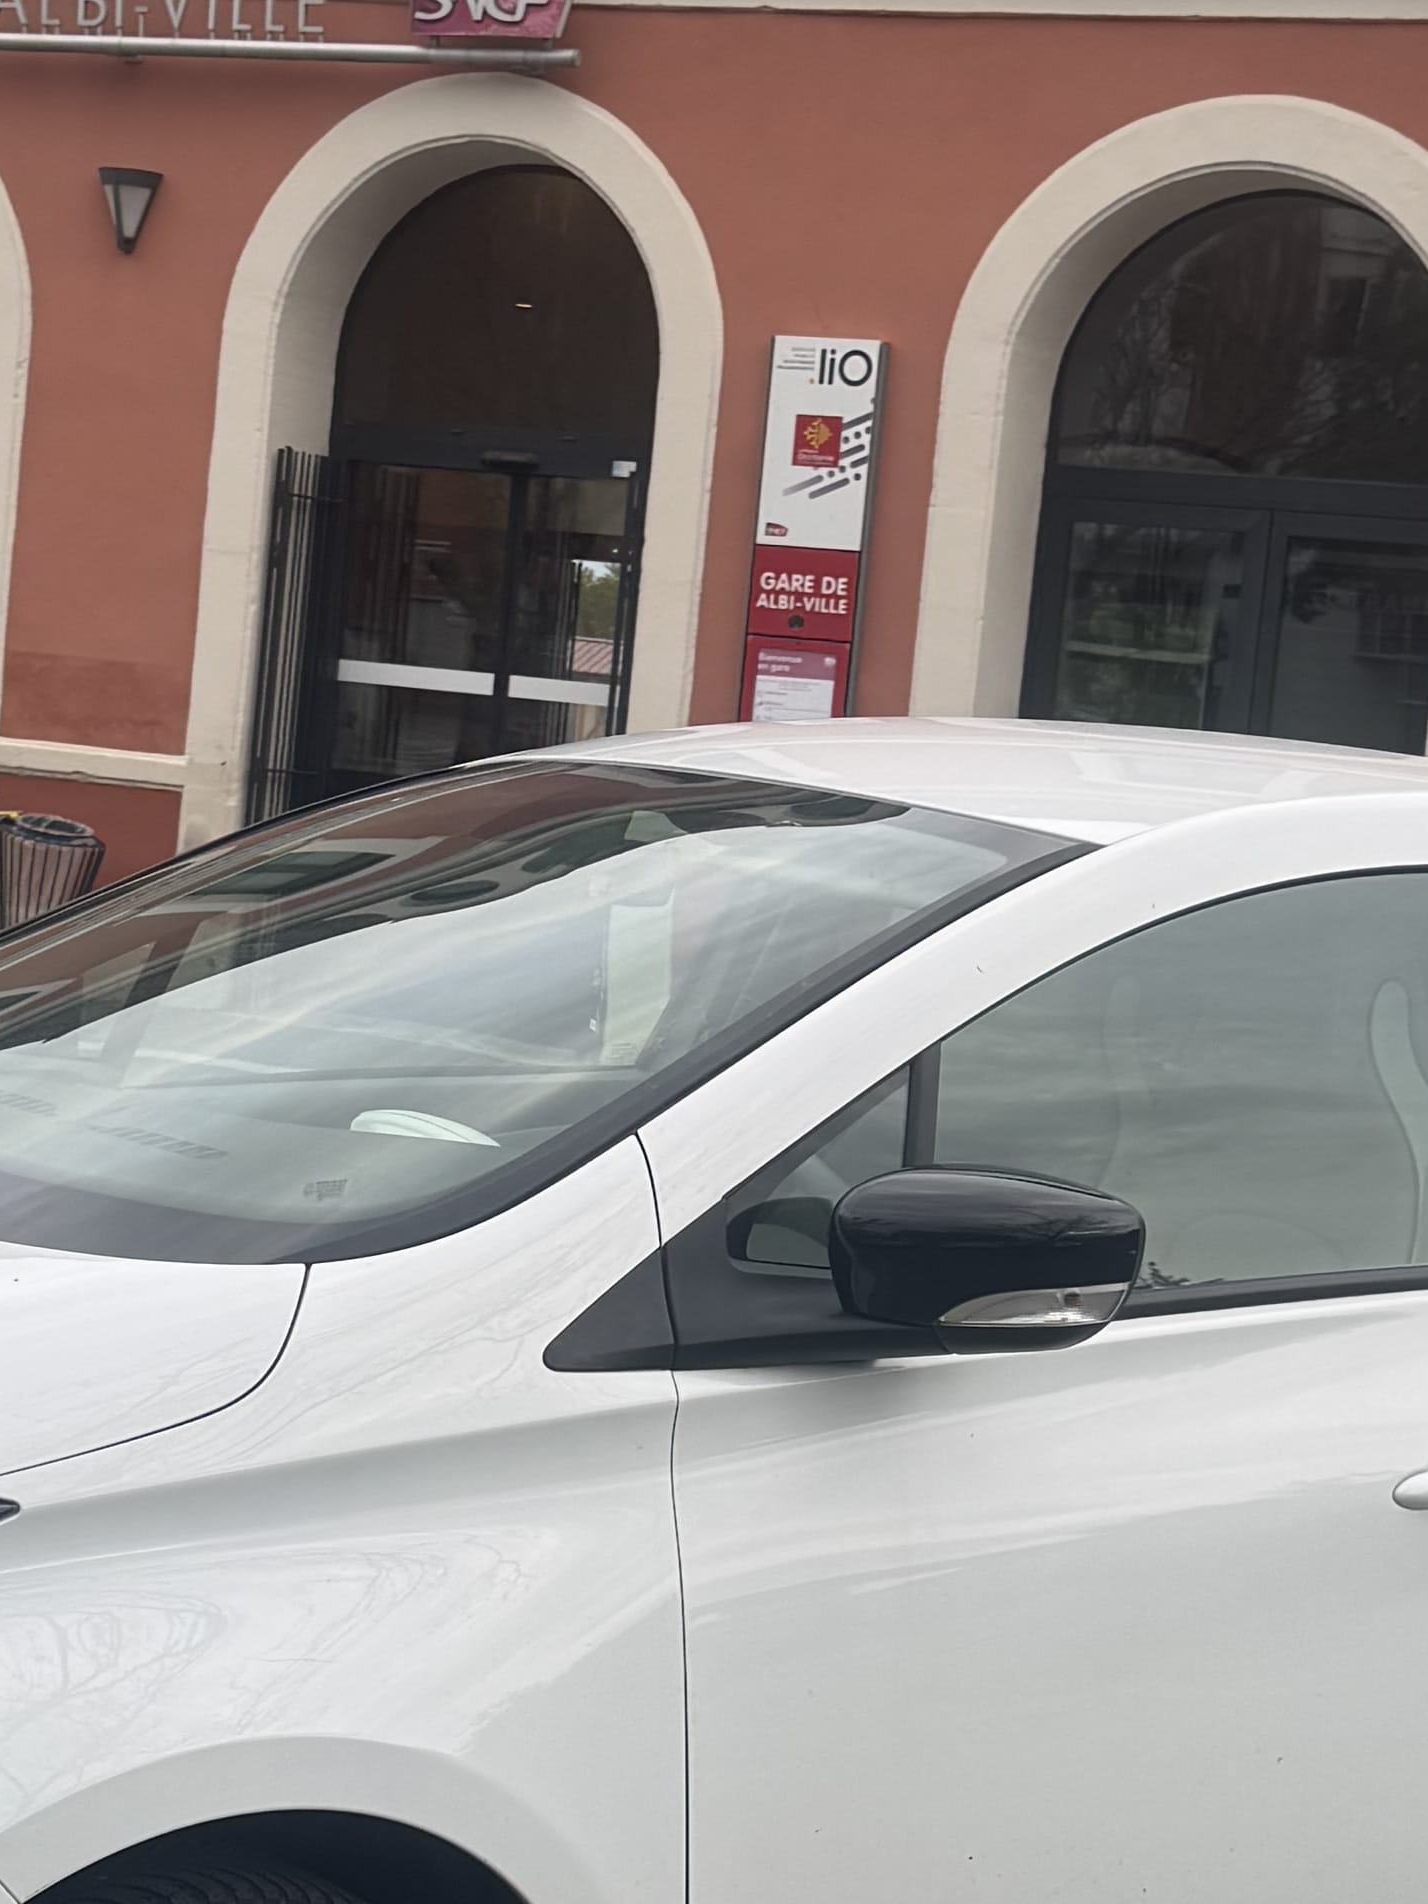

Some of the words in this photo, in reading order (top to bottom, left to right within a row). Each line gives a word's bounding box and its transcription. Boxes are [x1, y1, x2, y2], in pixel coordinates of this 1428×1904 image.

[760, 571, 816, 593] GARE
[821, 575, 849, 596] DE
[755, 592, 849, 614] ALBI-VILLE
